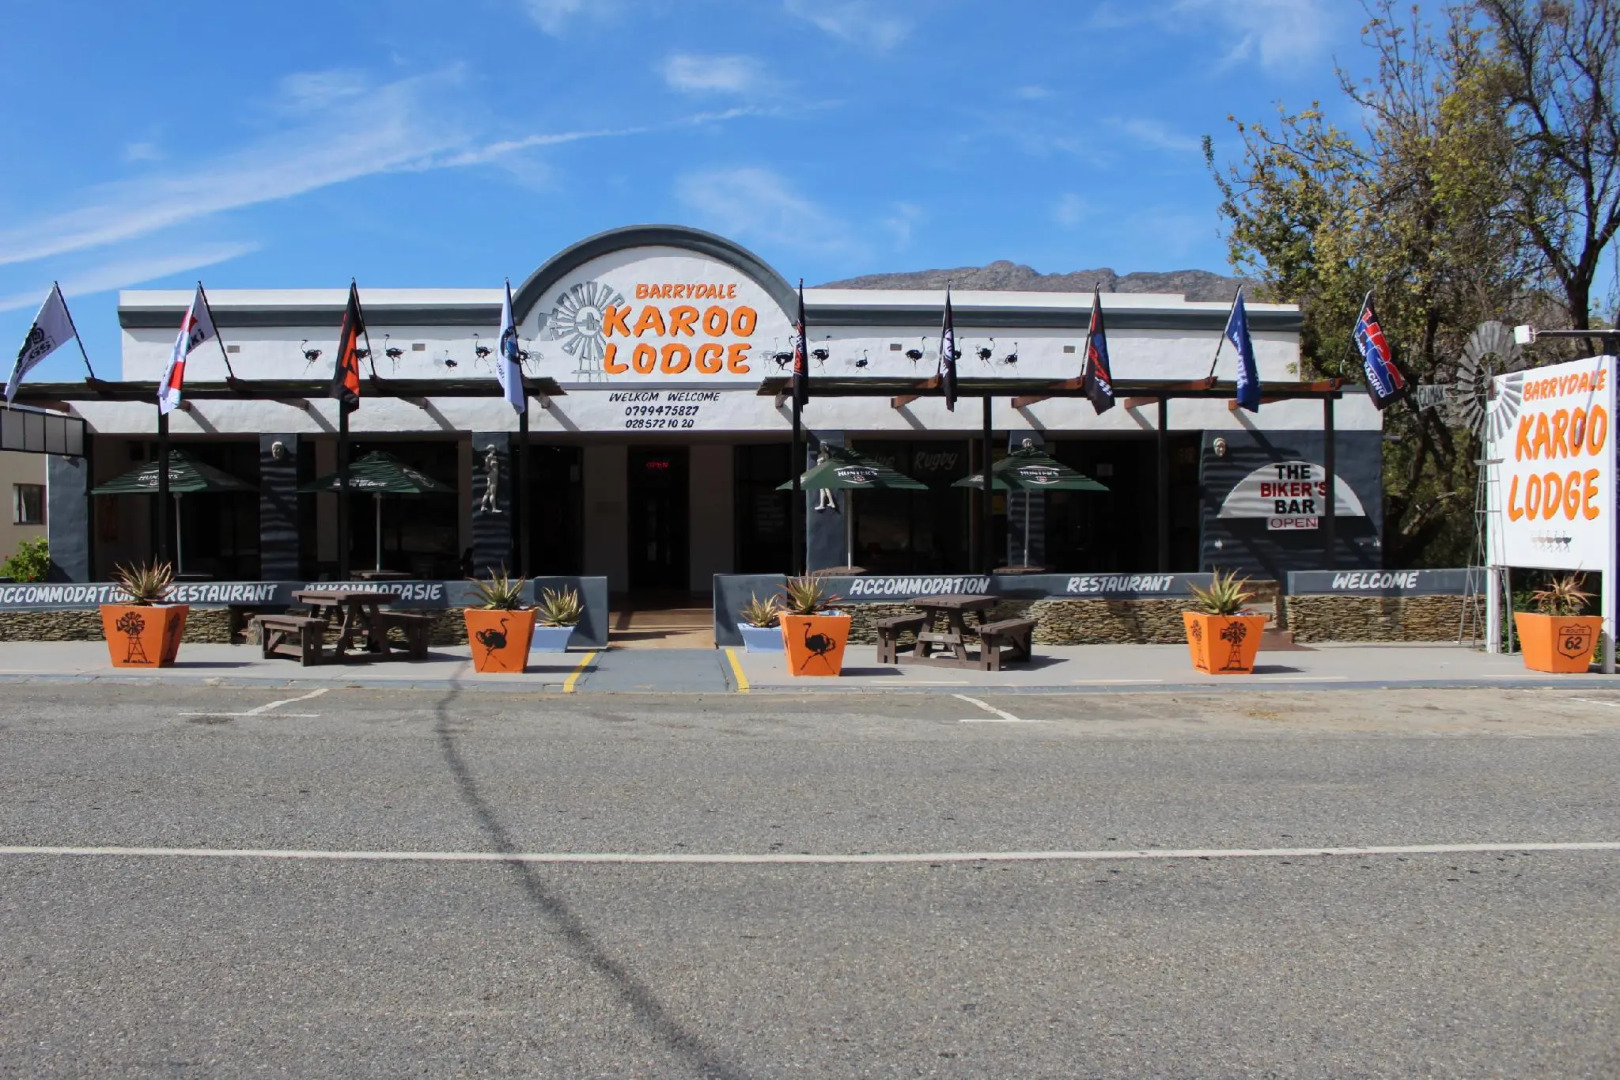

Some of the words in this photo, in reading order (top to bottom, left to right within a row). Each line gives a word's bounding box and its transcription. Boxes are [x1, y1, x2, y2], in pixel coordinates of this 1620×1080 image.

[635, 283, 738, 300] BARRYDALE
[602, 305, 758, 338] KAROO
[603, 343, 752, 375] LODGE
[1522, 368, 1607, 403] BARRYDALE
[608, 392, 660, 402] WELKOM
[667, 392, 721, 402] WELCOME
[625, 405, 700, 416] 0799475827
[1514, 403, 1608, 463] KAROO
[645, 461, 670, 470] OPEN
[915, 451, 959, 472] Rugby
[1274, 464, 1311, 480] THE
[1260, 482, 1326, 498] BIKER'S
[1507, 468, 1601, 523] LODGE
[1274, 499, 1316, 515] BAR
[1270, 517, 1318, 529] OPEN
[850, 577, 990, 595] ACCOMMODATION
[1067, 575, 1175, 593] RESTAURANT
[1332, 570, 1420, 589] WELCOME
[164, 584, 278, 602] RESTAURANT
[1565, 636, 1583, 650] 62
